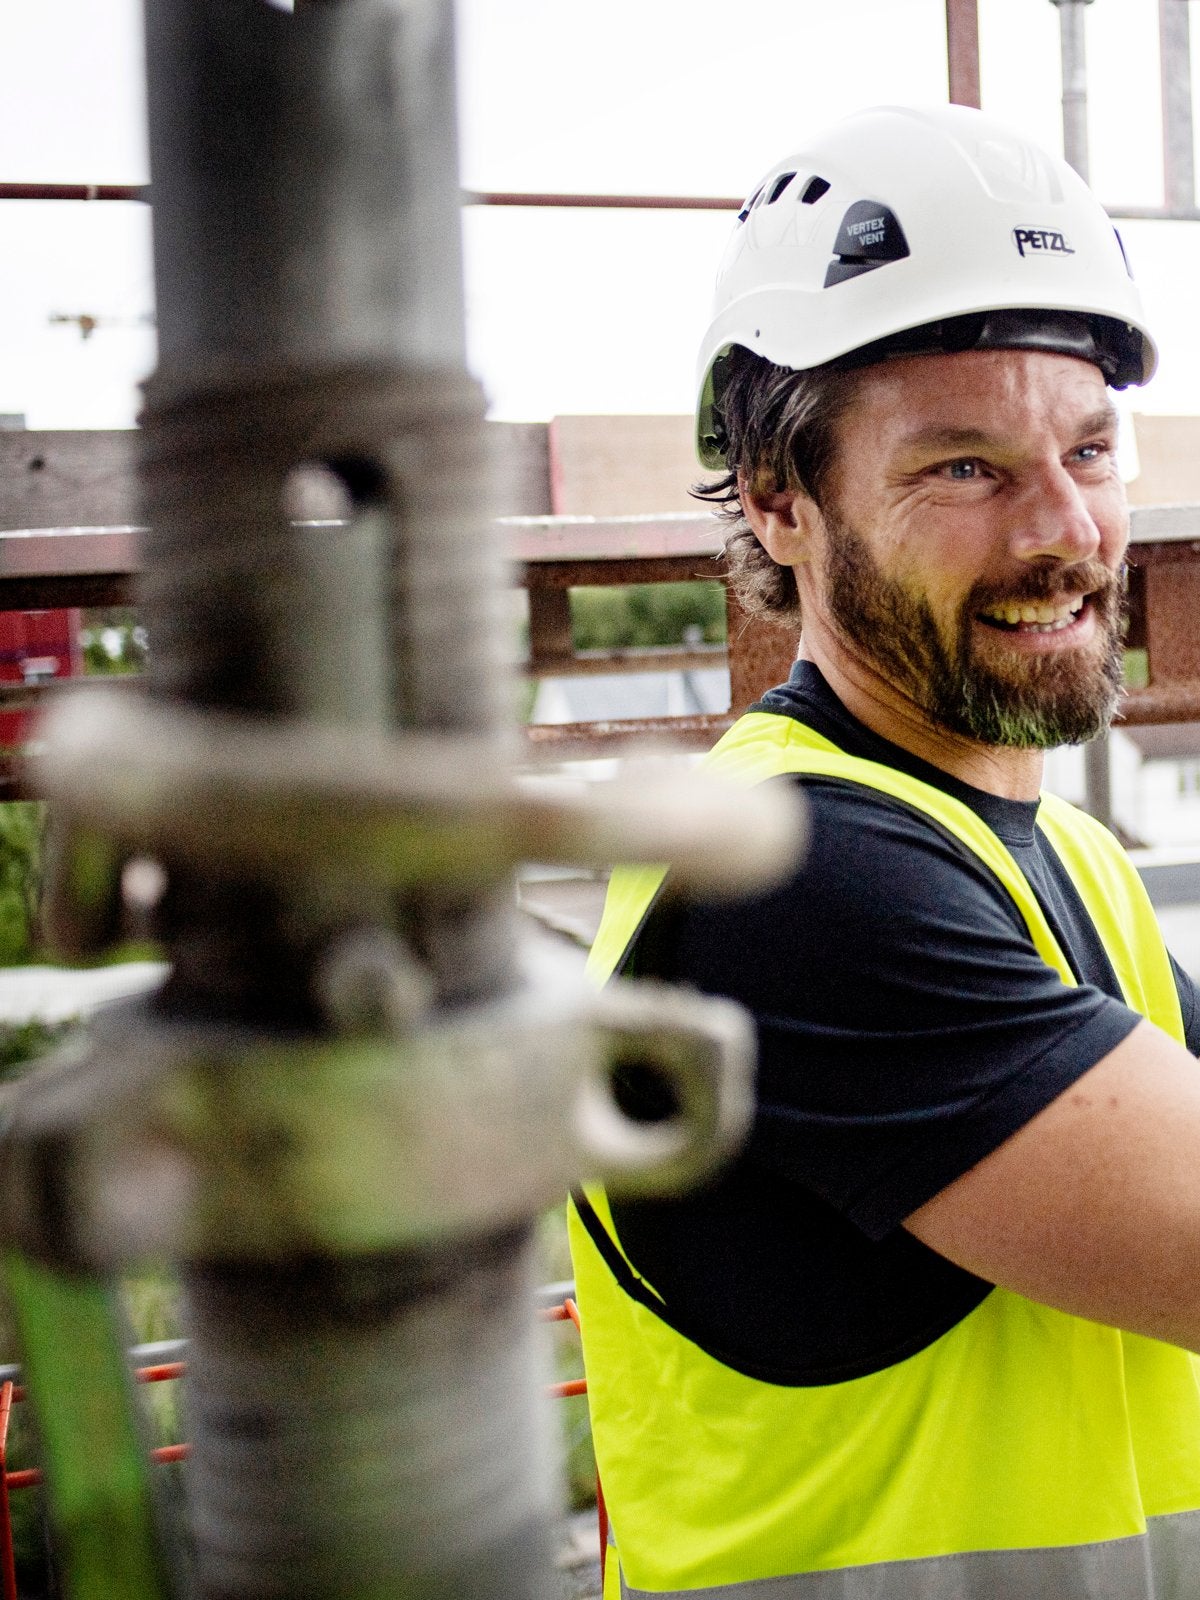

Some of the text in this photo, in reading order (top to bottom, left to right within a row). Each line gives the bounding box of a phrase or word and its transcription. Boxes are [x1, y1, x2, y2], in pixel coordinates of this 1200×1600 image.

[847, 217, 885, 236] VERTEX
[859, 230, 885, 246] VENT
[1014, 229, 1075, 258] PETZL
